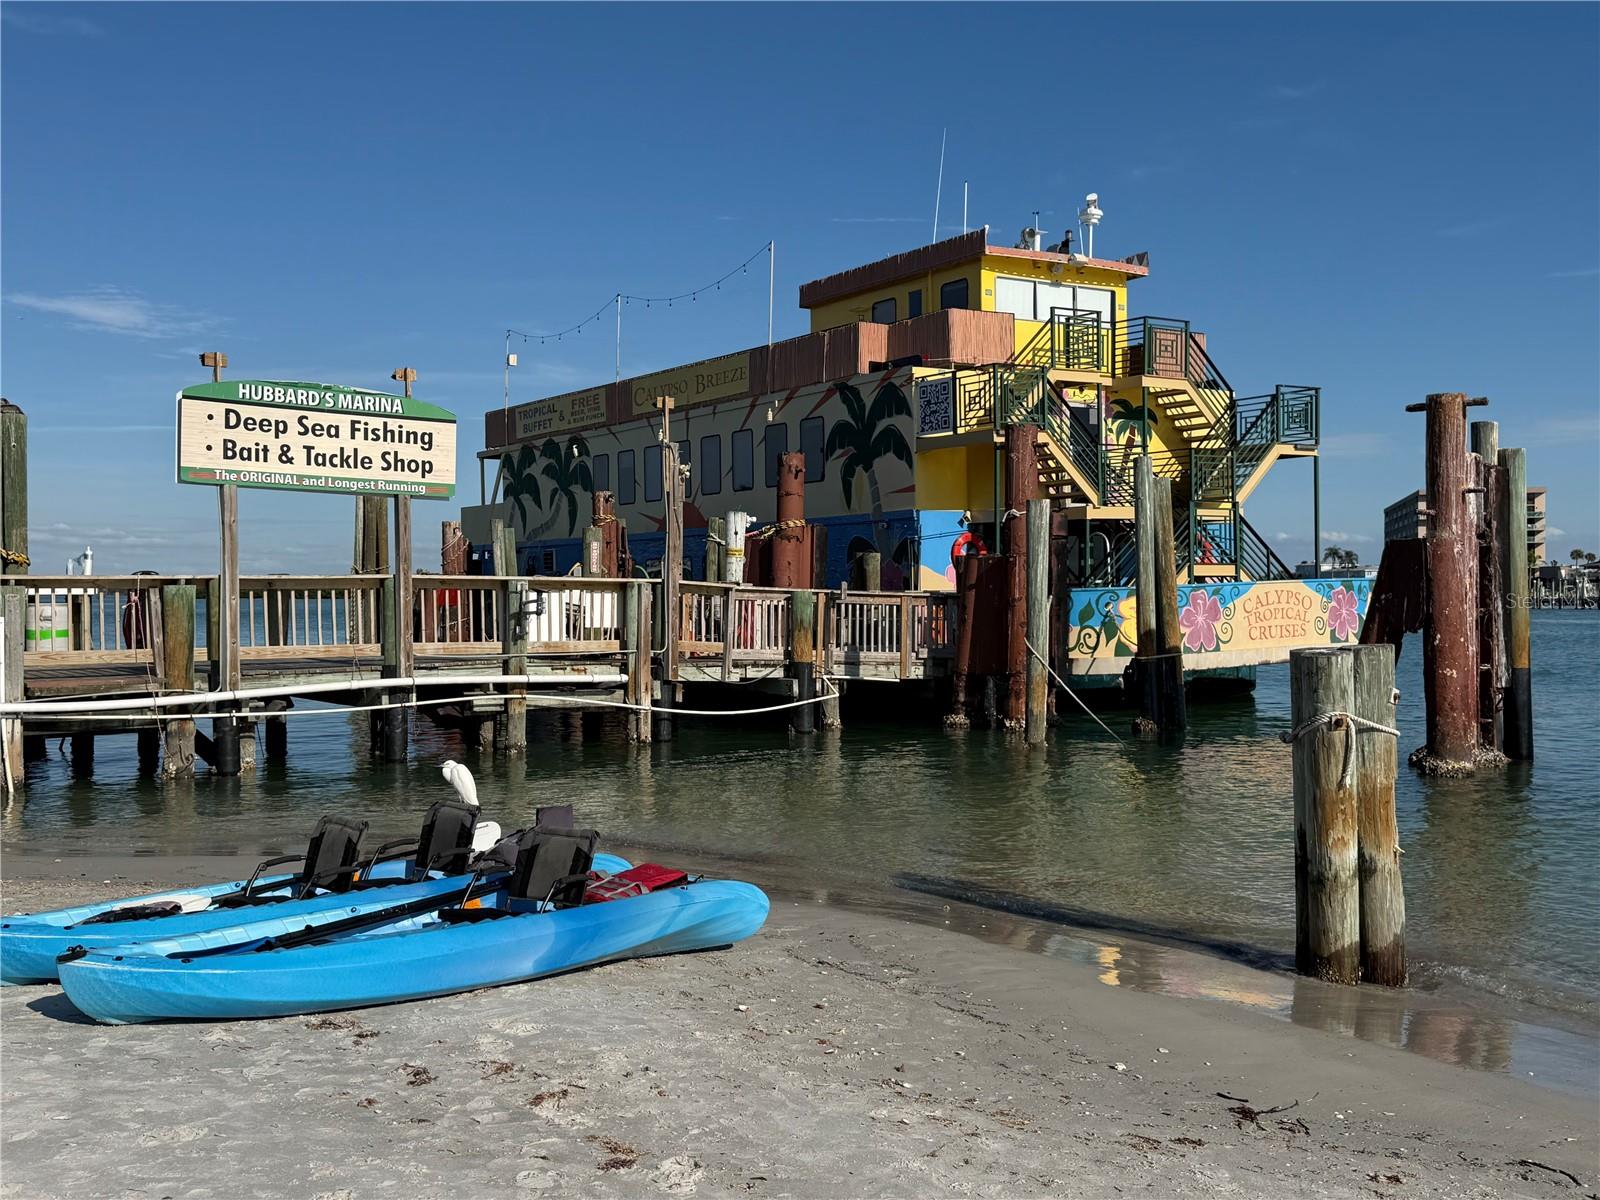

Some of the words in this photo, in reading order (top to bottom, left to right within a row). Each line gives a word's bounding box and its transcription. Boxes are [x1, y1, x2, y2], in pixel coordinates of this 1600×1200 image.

[695, 366, 747, 395] BREEZE
[239, 383, 336, 407] HUBBARD'S
[338, 393, 404, 414] MARINA
[571, 393, 600, 410] FREE
[518, 402, 558, 421] TROPICAL
[224, 408, 288, 439] Deep
[297, 415, 340, 438] Sea
[350, 419, 434, 452] Fishing
[523, 417, 553, 434] BUFFET
[222, 438, 270, 463] Bait
[278, 444, 295, 465] &
[302, 445, 373, 470] Tackle
[381, 450, 434, 479] Shop
[214, 469, 238, 481] The
[240, 471, 300, 485] ORIGINAL
[302, 477, 325, 487] and
[328, 477, 376, 491] Longest
[378, 480, 426, 495] Running
[1243, 589, 1313, 614] CALYPSO
[1244, 607, 1310, 627] TROPICAL
[1248, 622, 1307, 641] CRUISES
